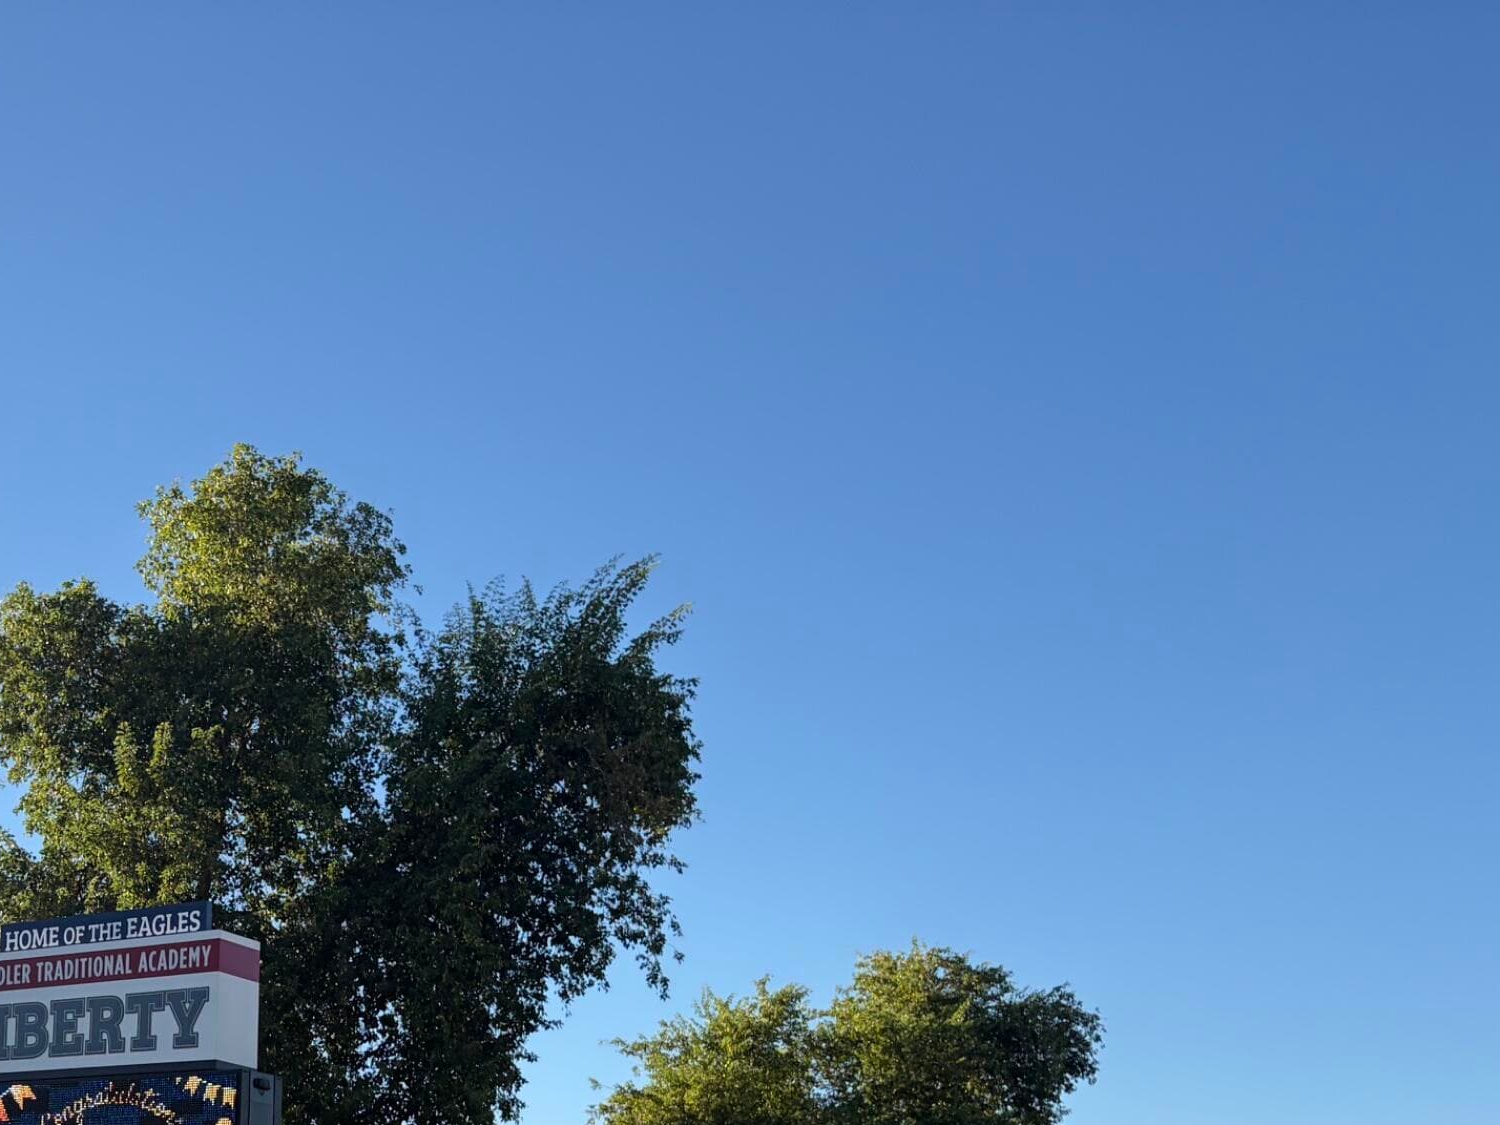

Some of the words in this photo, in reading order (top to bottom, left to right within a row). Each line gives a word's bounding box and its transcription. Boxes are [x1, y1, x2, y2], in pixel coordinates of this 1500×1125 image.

[5, 925, 59, 951] HOME
[64, 925, 85, 945] OF
[88, 921, 122, 942] THE
[126, 910, 201, 938] EAGLES
[36, 954, 132, 984] TRADITIONAL
[138, 945, 212, 973] ACADEMY
